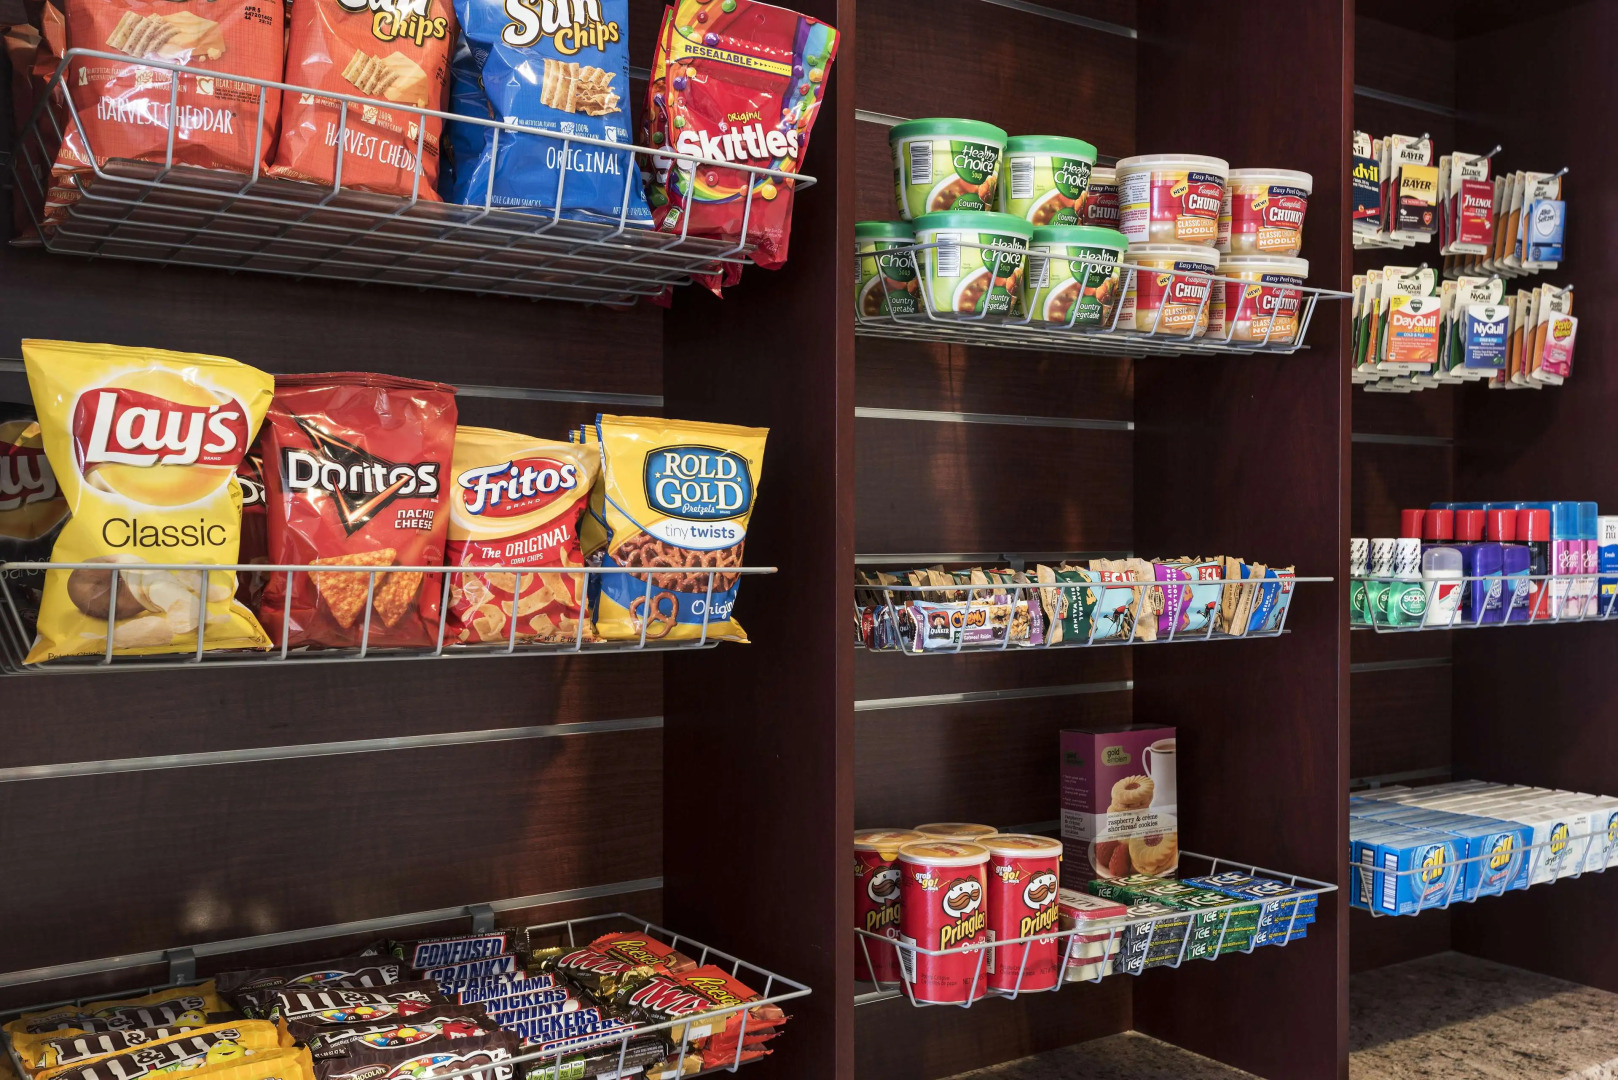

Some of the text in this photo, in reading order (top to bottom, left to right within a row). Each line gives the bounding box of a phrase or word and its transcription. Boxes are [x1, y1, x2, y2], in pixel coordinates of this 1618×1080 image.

[372, 11, 448, 47] Chips
[501, 0, 619, 55] Sun Chips
[684, 44, 752, 66] RESEALABLE
[165, 103, 234, 135] CHEDDAR
[676, 123, 798, 171] Skittles
[962, 144, 998, 161] Healthy
[546, 146, 621, 176] ORIGINAL
[1401, 150, 1424, 160] BAYER
[954, 154, 993, 172] Choice
[1461, 167, 1481, 176] TYLENOL
[1054, 170, 1088, 188] Choice
[1402, 179, 1432, 190] BAYER
[1172, 186, 1187, 195] NEW!
[958, 198, 984, 210] Country
[1464, 194, 1492, 208] TYLENOL
[1088, 204, 1120, 218] CHUN
[1269, 206, 1304, 226] CHUNKY
[1178, 220, 1200, 228] CLASSIC
[1178, 227, 1214, 235] NOODLE
[1258, 232, 1282, 240] CLASSIC
[1259, 238, 1296, 246] NOODLE
[1397, 282, 1422, 292] DayQuil
[1470, 292, 1492, 301] NyQuil
[1393, 314, 1437, 330] DayQuil
[1474, 322, 1504, 336] NyQuil
[86, 391, 241, 467] Lay's
[287, 450, 439, 495] Doritos
[663, 452, 737, 480] ROLD
[458, 460, 577, 516] Fritos
[656, 478, 744, 510] GOLD
[506, 498, 541, 510] BRAND
[682, 502, 716, 516] Pretzels
[397, 508, 434, 520] NACHO
[394, 518, 433, 530] CHEESE
[102, 518, 226, 548] Classic
[665, 524, 736, 540] tiny twists
[482, 525, 571, 560] The ORIGINAL
[510, 552, 544, 564] CORN CHIPS
[952, 610, 986, 628] Chewy
[1107, 750, 1120, 758] gold
[1108, 818, 1134, 826] raspberry
[1108, 820, 1158, 832] shortbread cookies
[1551, 824, 1568, 852] all
[1490, 836, 1514, 870] all
[996, 864, 1012, 874] grab
[1422, 846, 1446, 882] all
[915, 871, 932, 881] grab
[1002, 870, 1020, 881] go!
[1205, 872, 1252, 886] ICE
[922, 878, 938, 890] go!
[1146, 883, 1196, 896] ICE
[1245, 882, 1292, 896] ICE
[1183, 892, 1234, 906] ICE
[1126, 902, 1170, 918] ICE
[1266, 900, 1280, 913] ICE
[1020, 902, 1059, 942] Pringle
[1203, 910, 1218, 924] ICE
[940, 910, 986, 951] Pringles
[1136, 922, 1152, 936] ICE
[1194, 926, 1210, 940] ICE
[1256, 931, 1267, 944] CE
[415, 938, 503, 968] CONFUSED
[1132, 940, 1148, 953] ICE
[1192, 943, 1206, 958] ICE
[430, 957, 512, 982] CRANKY
[440, 972, 518, 996] SPACEY
[462, 977, 552, 1004] DRAMA MAMA
[496, 1000, 566, 1026] WHINY
